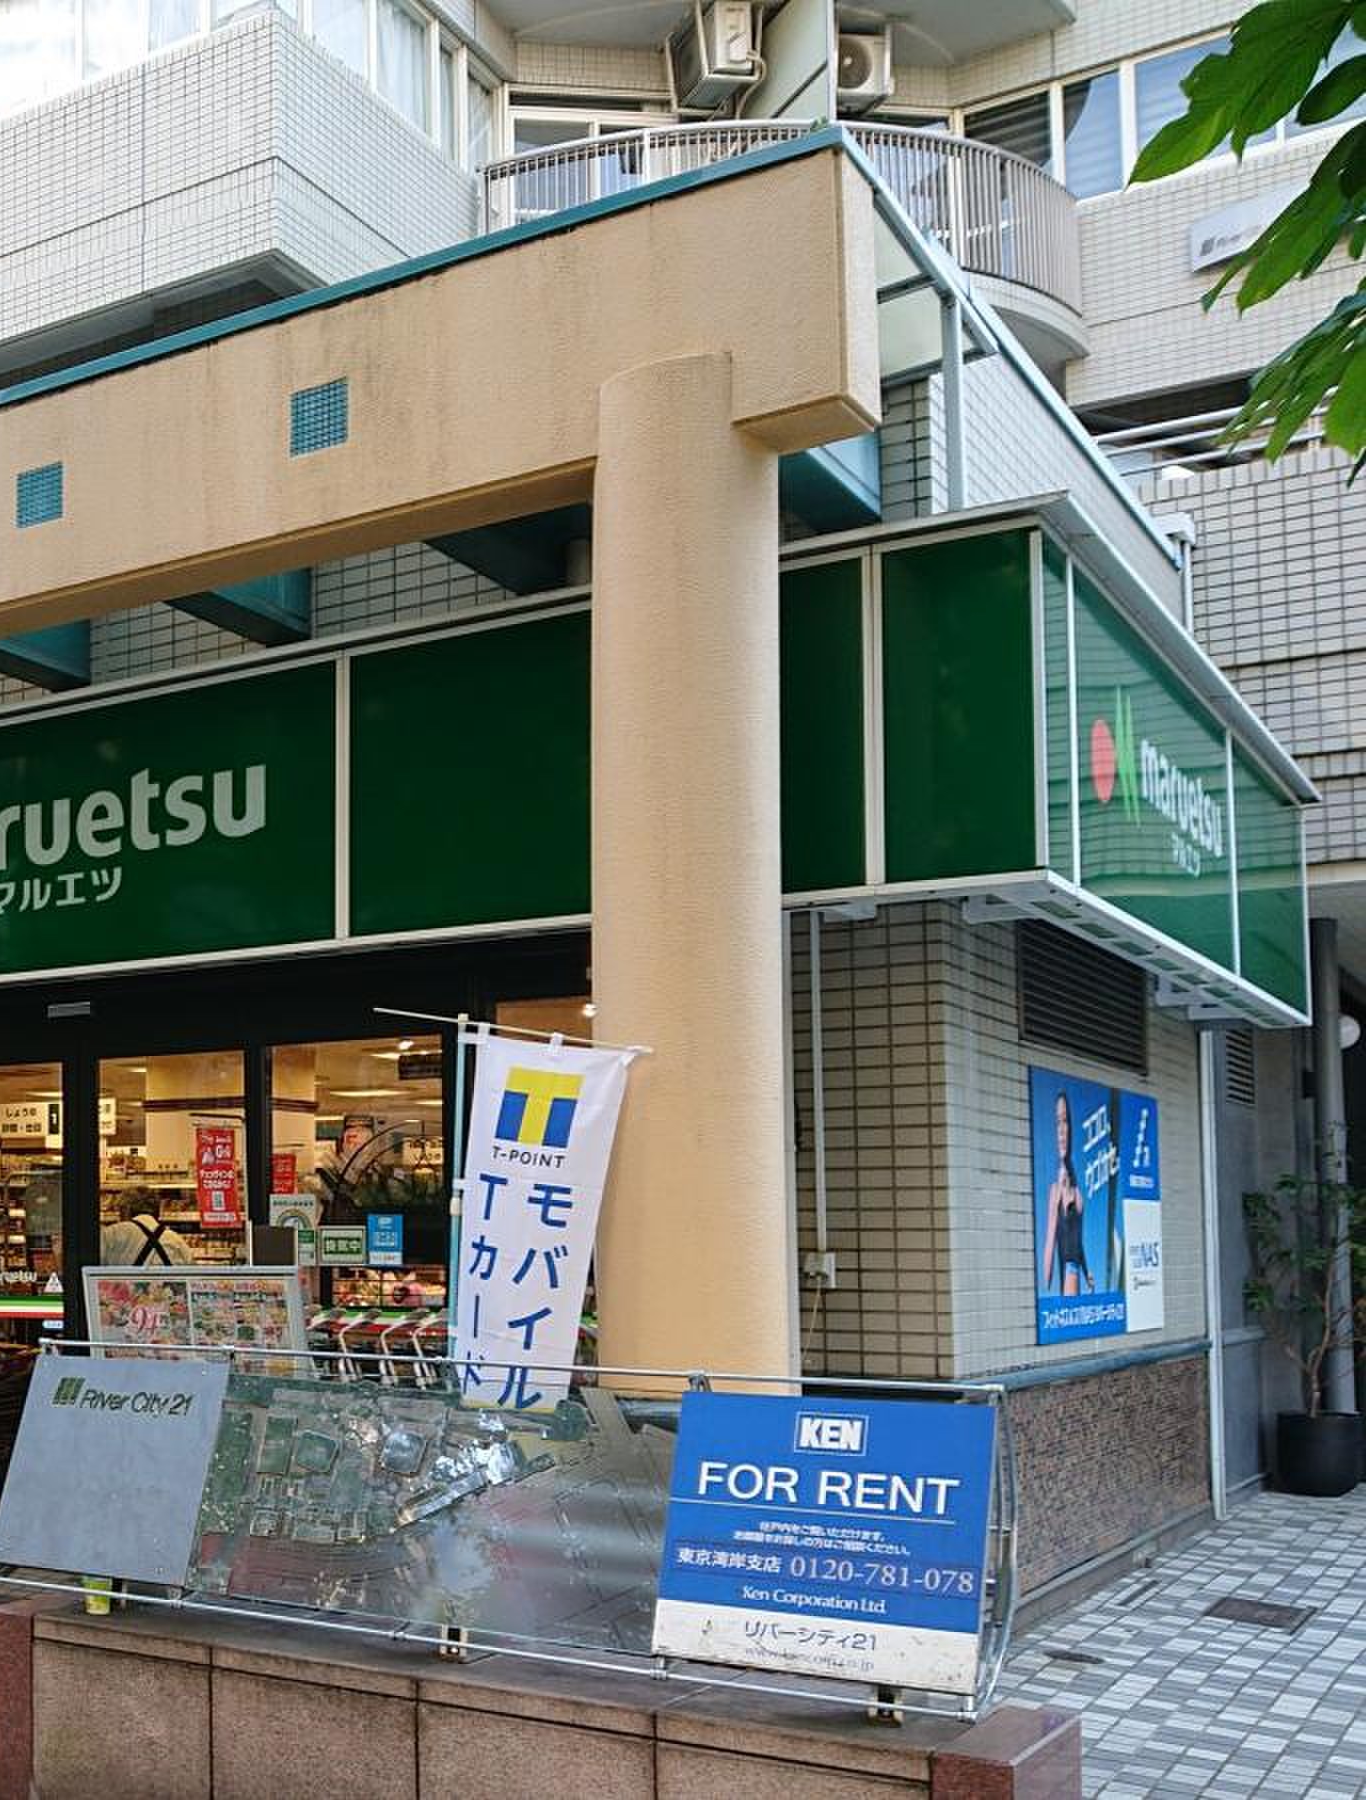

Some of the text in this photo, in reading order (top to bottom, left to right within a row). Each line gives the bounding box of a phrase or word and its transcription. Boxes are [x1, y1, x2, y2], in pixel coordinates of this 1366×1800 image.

[1141, 739, 1222, 857] maruetsu
[491, 1146, 566, 1169] T-POINT
[464, 1173, 508, 1395] Tカード
[497, 1183, 573, 1408] モバイル
[80, 1389, 195, 1417] River City 21
[799, 1417, 863, 1451] KEN
[697, 1461, 960, 1515] FOR RENT
[677, 1548, 975, 1594] 東京湾岸支店 0120-781-078
[742, 1585, 770, 1601] Ken
[772, 1589, 858, 1612] Corporation
[745, 1620, 877, 1651] リバーシティ21
